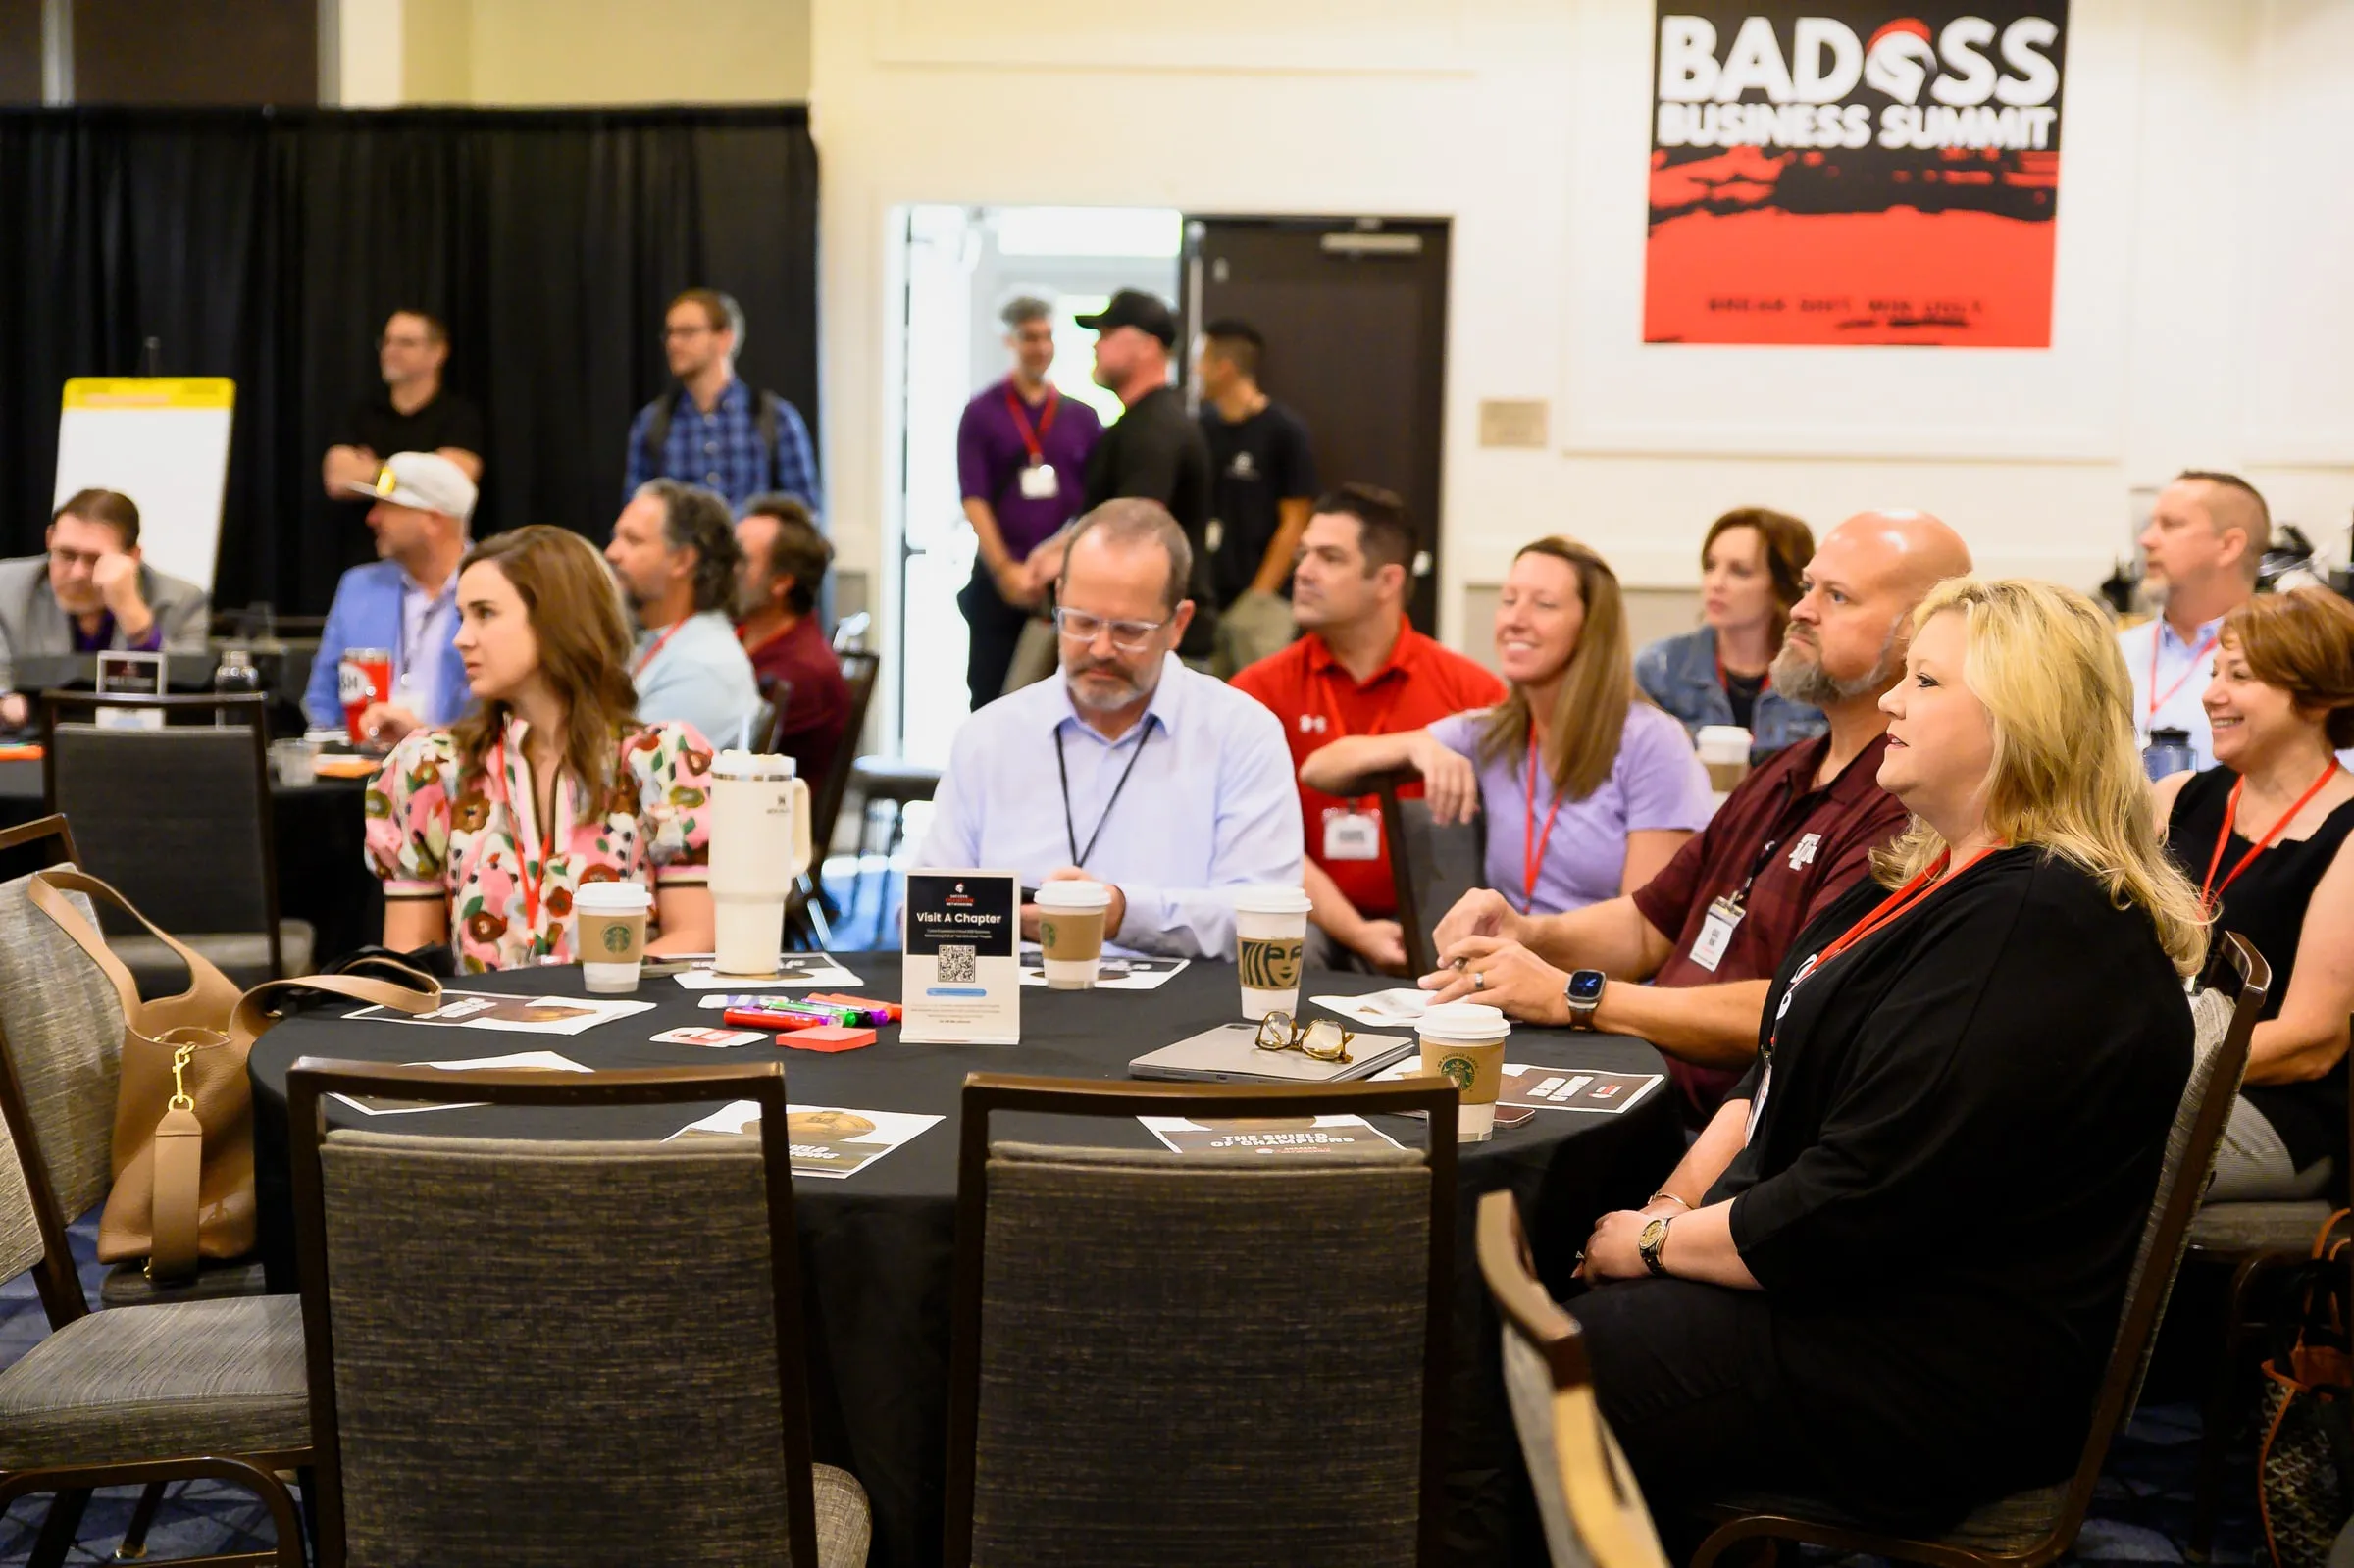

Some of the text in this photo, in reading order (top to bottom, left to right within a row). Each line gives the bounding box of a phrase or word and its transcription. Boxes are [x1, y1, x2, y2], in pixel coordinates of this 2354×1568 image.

[1658, 102, 2057, 149] BUSINESS SUMMIT
[916, 912, 1001, 926] Visit A Chapter
[1240, 1137, 1355, 1146] CHAMPIONS
[1262, 1133, 1328, 1141] SHIELD
